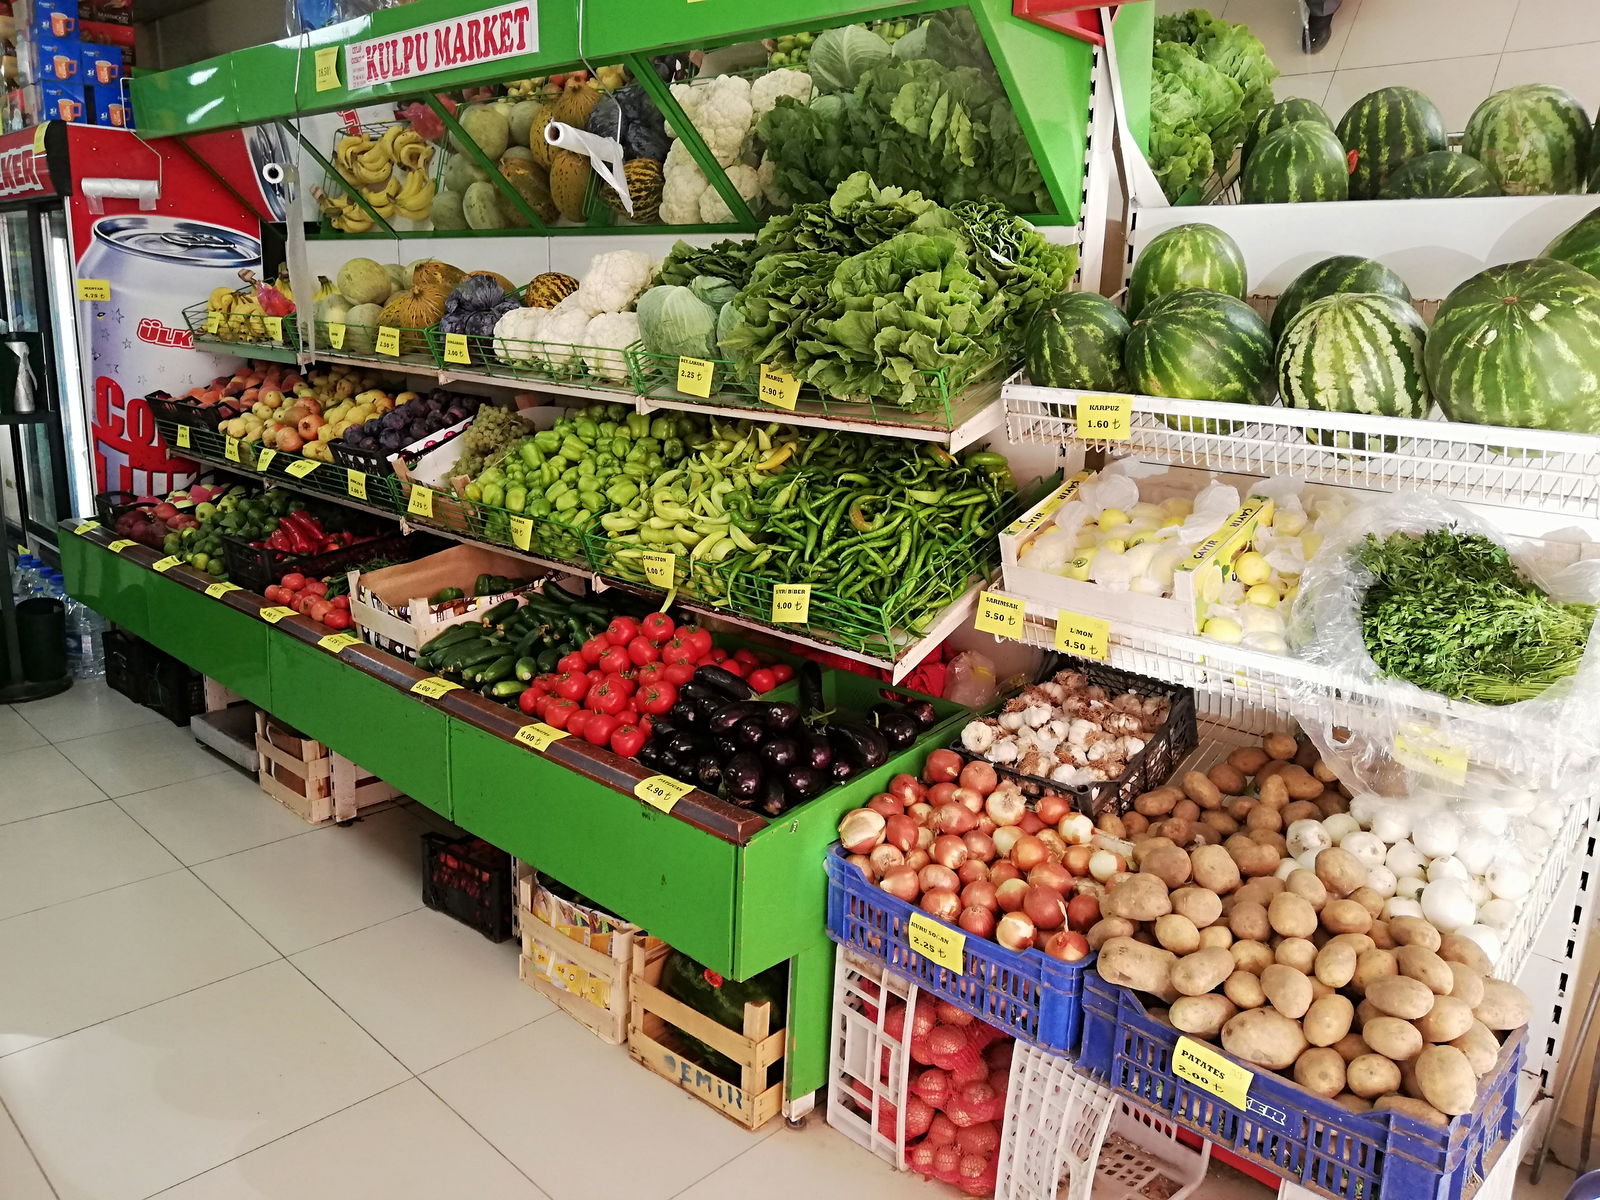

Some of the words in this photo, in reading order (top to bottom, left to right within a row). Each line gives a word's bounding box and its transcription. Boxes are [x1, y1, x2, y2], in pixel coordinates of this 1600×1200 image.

[365, 32, 429, 82] KULPU
[434, 6, 530, 69] MARKET
[137, 317, 197, 350] ÜLK
[680, 369, 695, 379] 2.25
[761, 385, 777, 396] 2.90
[1089, 404, 1120, 412] KARPUZ
[1087, 420, 1109, 429] 1.60
[1229, 508, 1253, 527] ÇAYIR
[777, 602, 792, 610] 4.00
[985, 610, 1005, 622] 5.50
[1069, 627, 1094, 638] LMON
[1064, 639, 1086, 651] 4.50
[520, 731, 535, 742] 4.00
[646, 783, 664, 797] 2.90
[913, 936, 935, 953] 2.25
[1181, 1049, 1225, 1080] PATATES
[1178, 1064, 1209, 1084] 2.00
